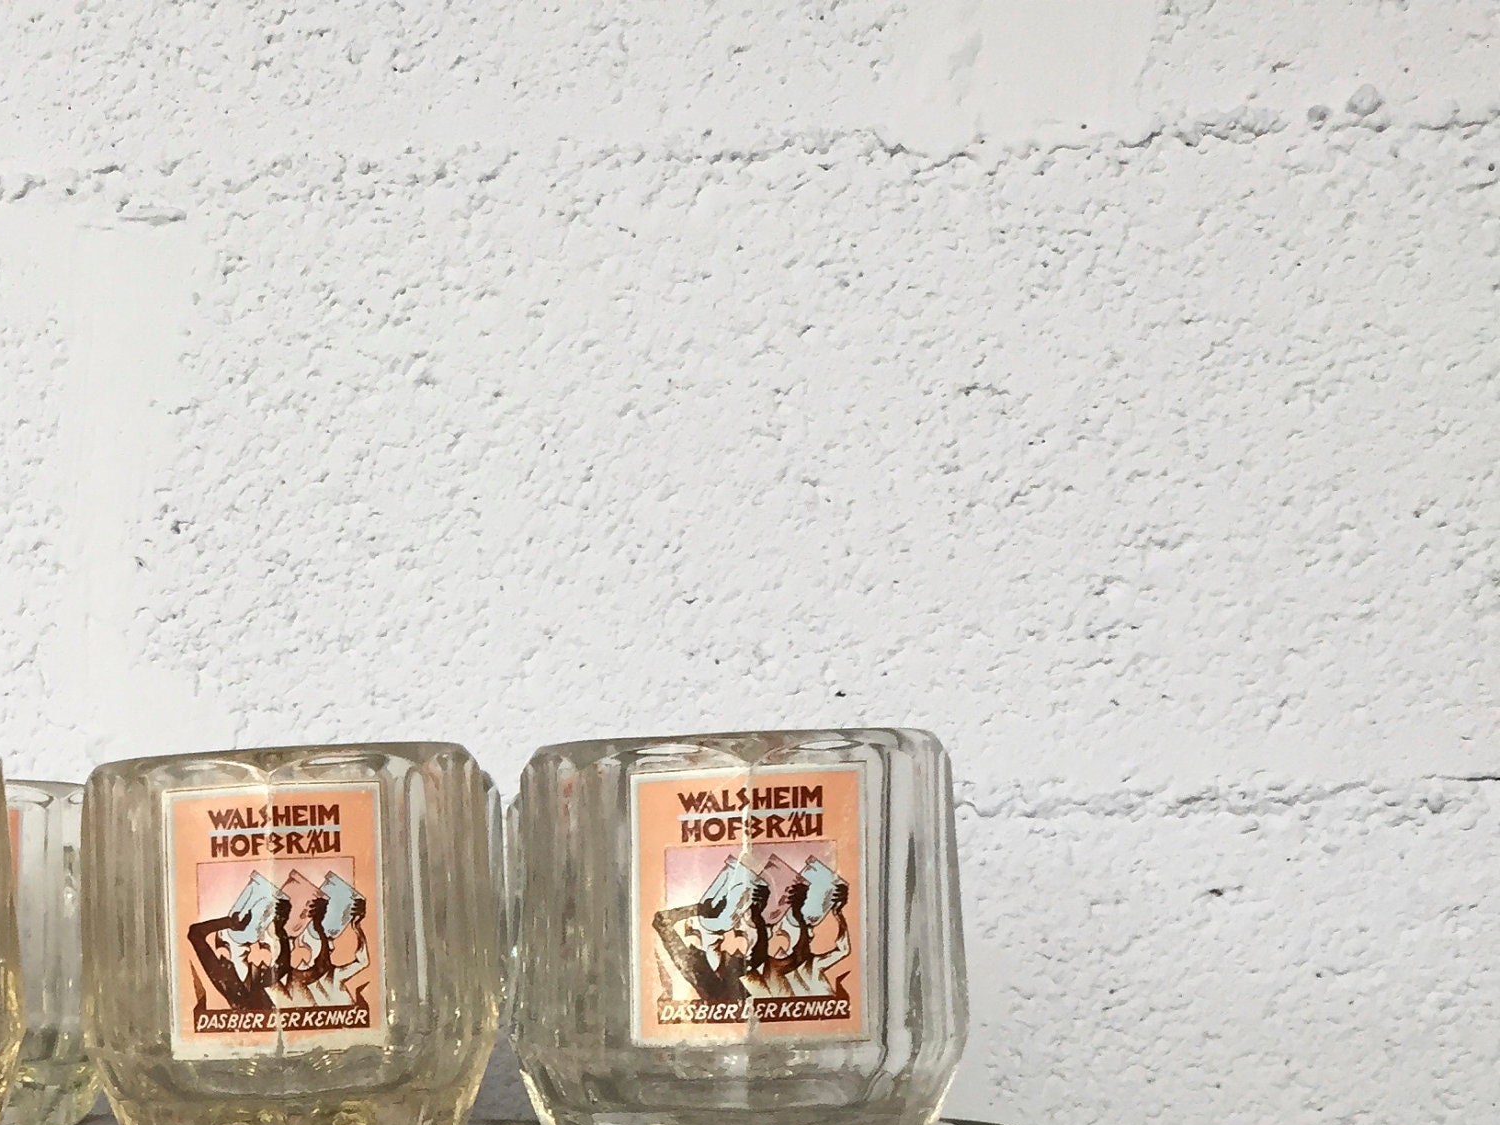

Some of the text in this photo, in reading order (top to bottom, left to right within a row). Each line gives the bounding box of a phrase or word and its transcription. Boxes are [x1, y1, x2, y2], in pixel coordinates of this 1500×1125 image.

[677, 786, 823, 812] WALSHEIM
[207, 804, 340, 829] WALSHEIM
[681, 812, 823, 843] HOFBRÄU
[210, 830, 341, 858] HOFBRÄU
[266, 1010, 301, 1030] DER
[302, 1006, 368, 1026] KENNER
[781, 998, 850, 1018] KENNER
